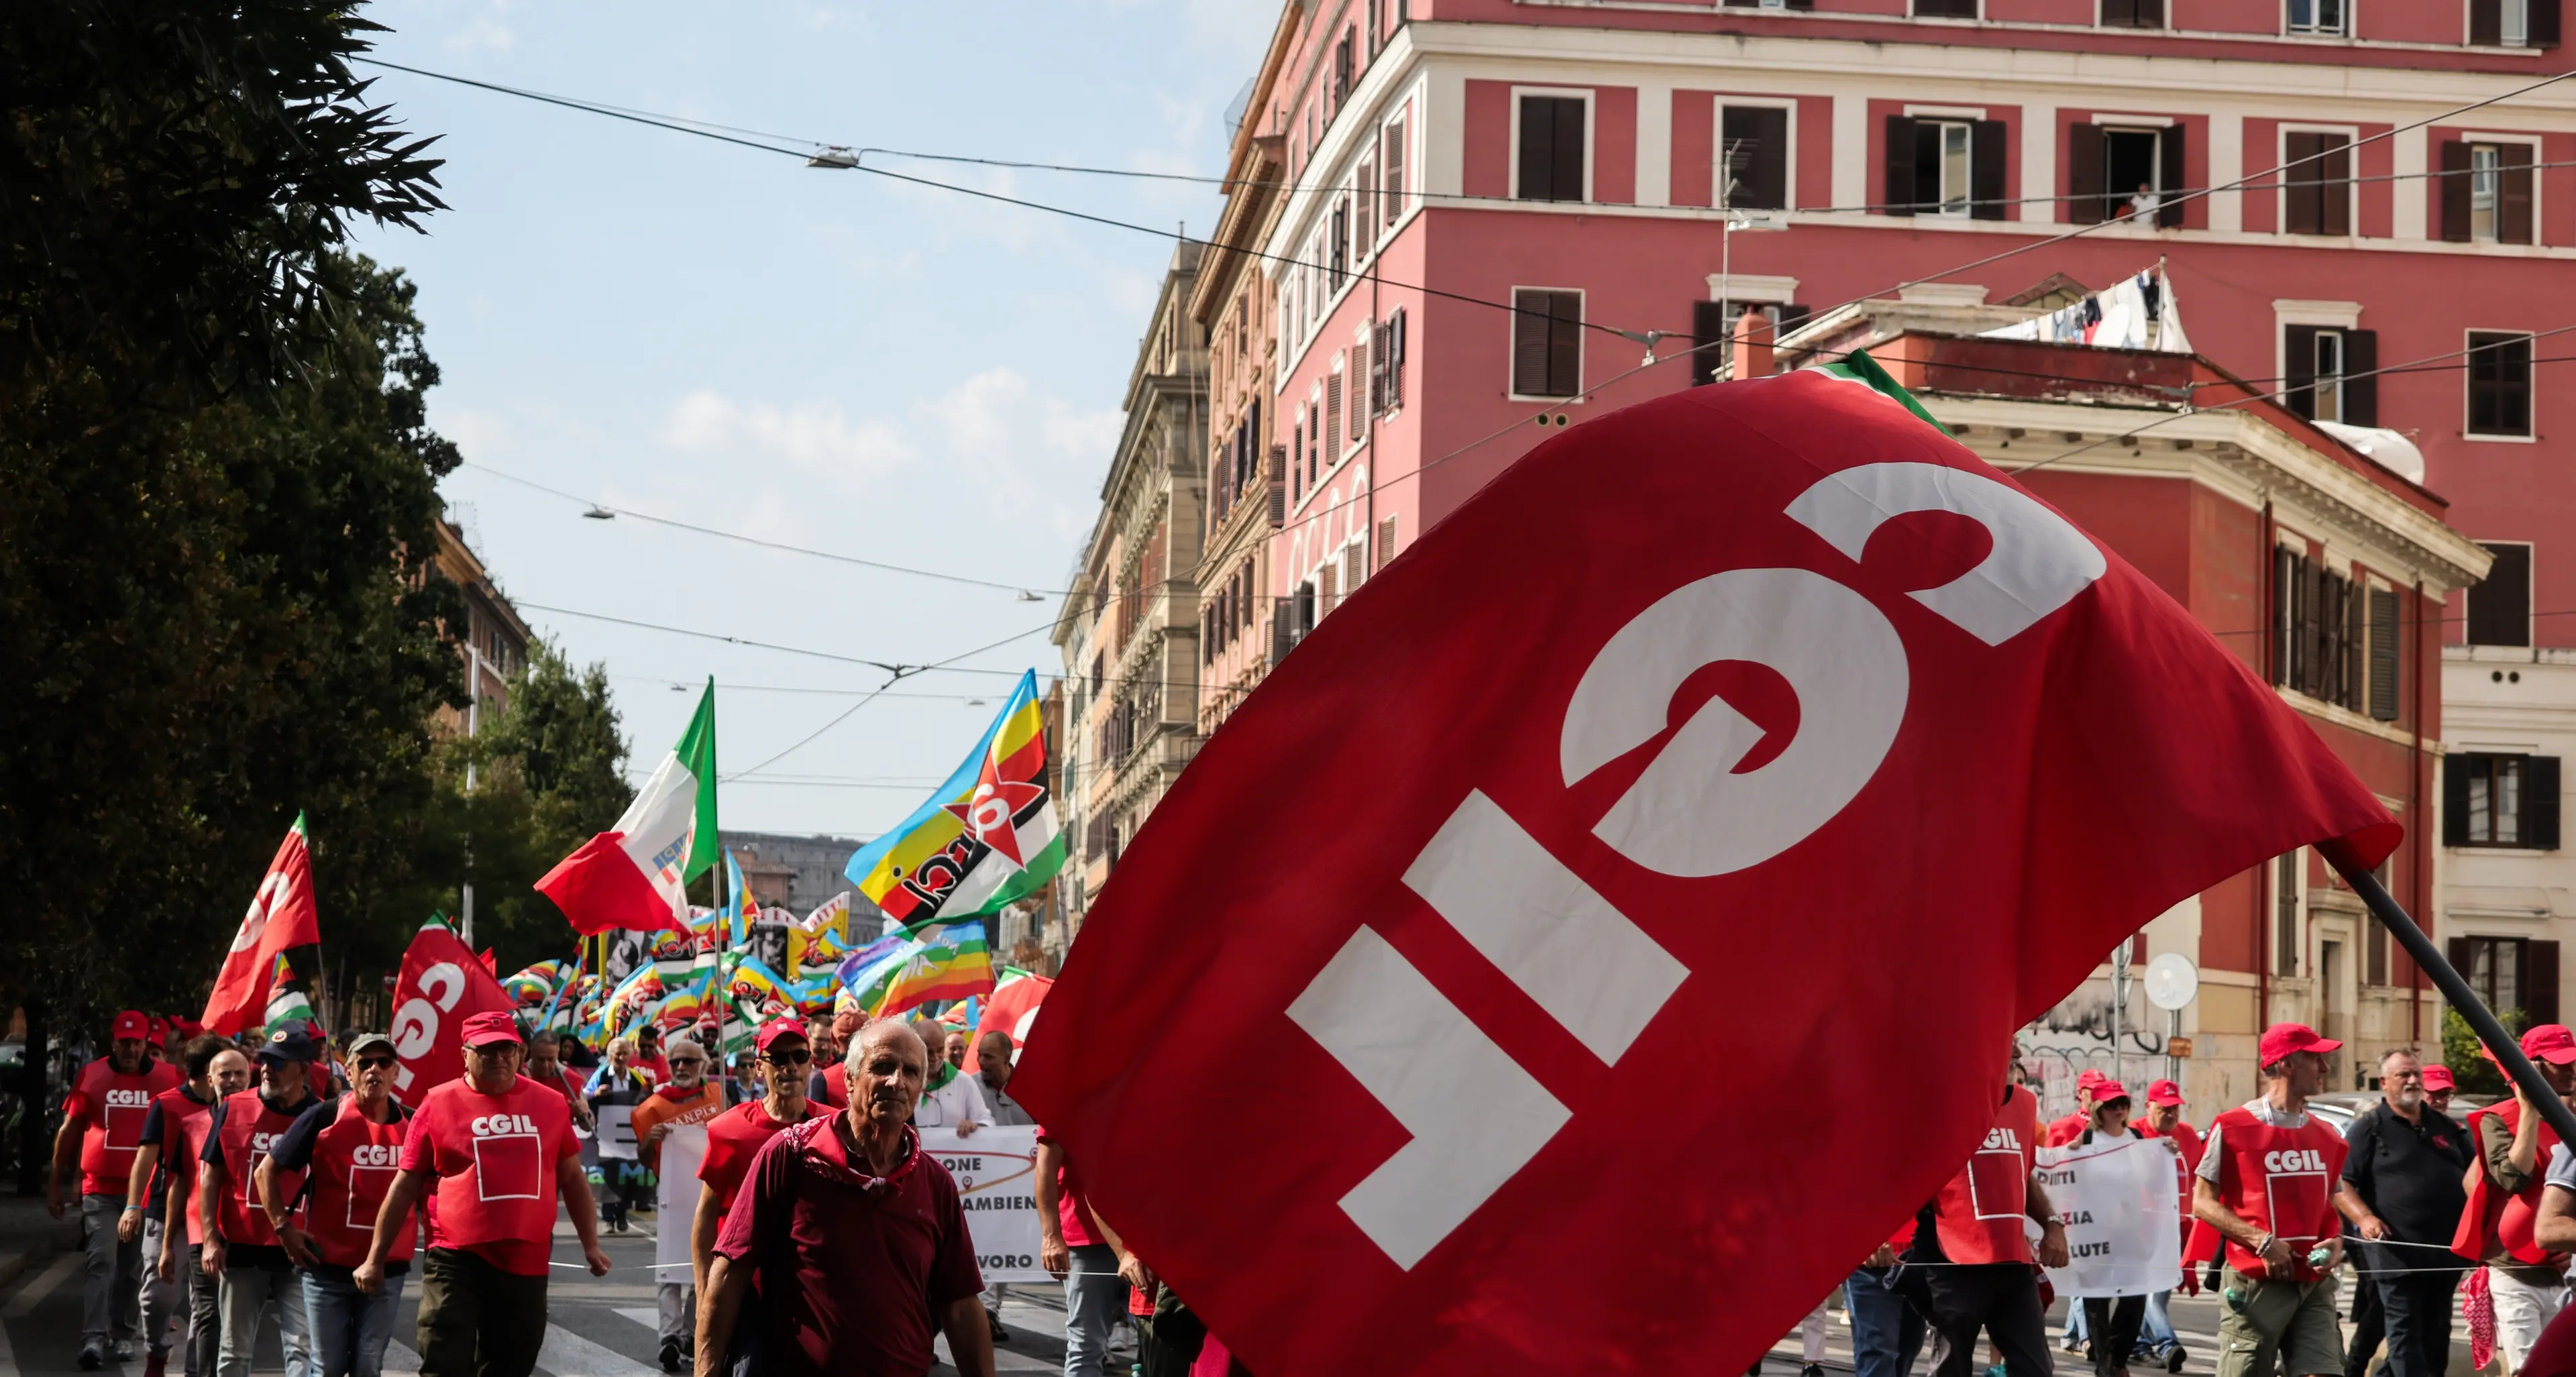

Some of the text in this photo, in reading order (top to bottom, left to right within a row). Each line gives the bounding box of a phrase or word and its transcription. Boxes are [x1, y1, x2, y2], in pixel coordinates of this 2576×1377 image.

[106, 1089, 150, 1104] CGIL
[472, 1114, 538, 1136] CGIL
[1978, 1127, 2021, 1149] GIL
[938, 1158, 981, 1171] ONE
[2264, 1150, 2326, 1172] CGIL
